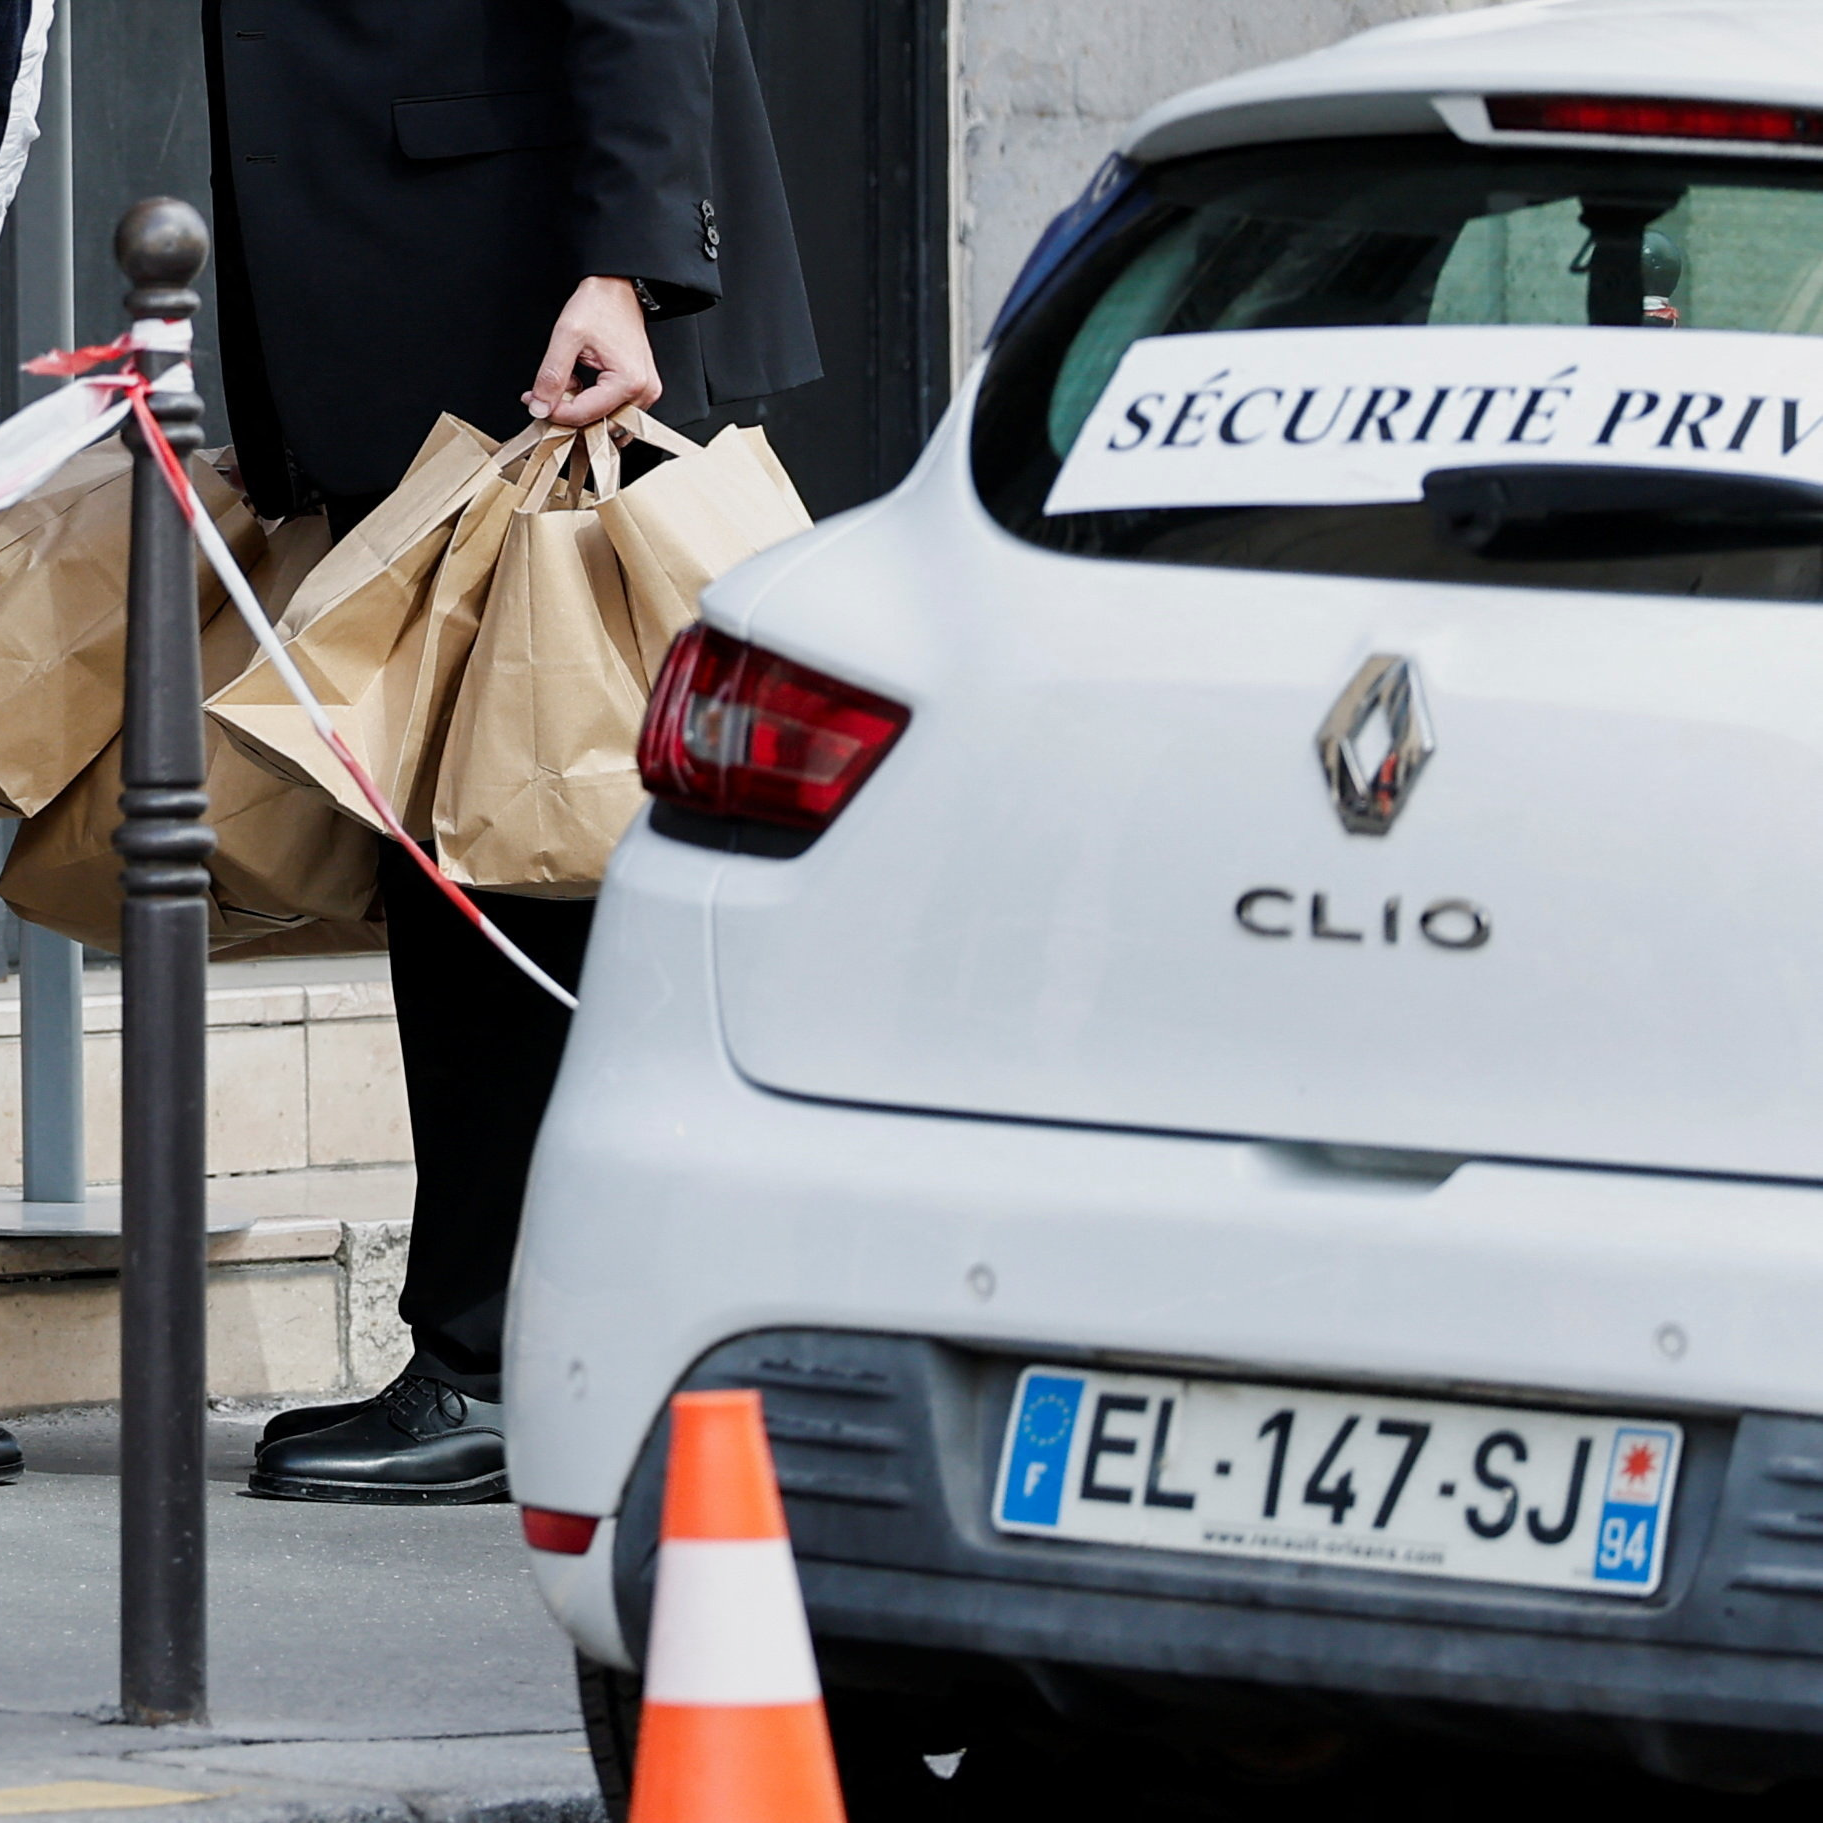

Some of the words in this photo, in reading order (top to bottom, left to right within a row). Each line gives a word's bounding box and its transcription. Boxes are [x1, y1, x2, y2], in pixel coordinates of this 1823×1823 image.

[1107, 367, 1579, 453] SÉCURITÉ
[1234, 887, 1491, 951] CLIO
[1022, 1462, 1048, 1499] F
[1599, 1517, 1649, 1572] 94
